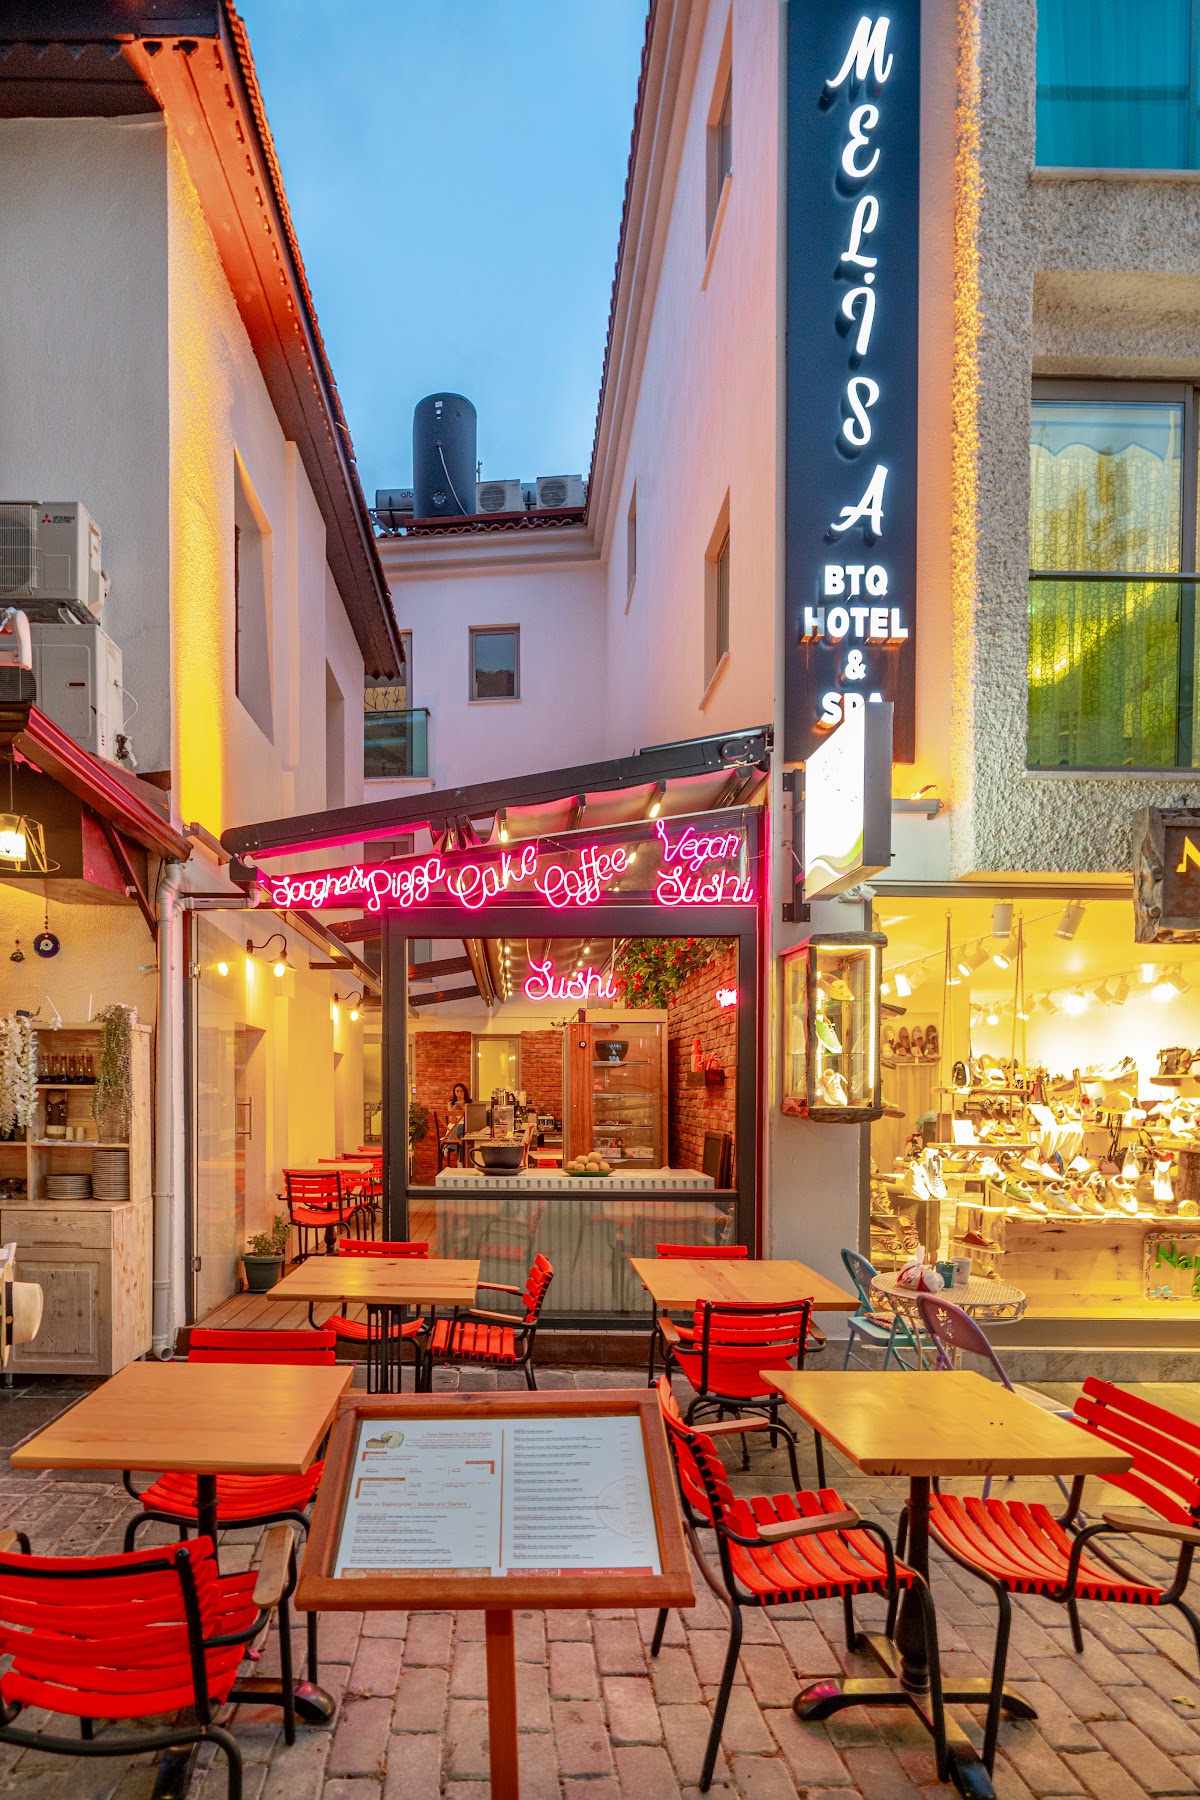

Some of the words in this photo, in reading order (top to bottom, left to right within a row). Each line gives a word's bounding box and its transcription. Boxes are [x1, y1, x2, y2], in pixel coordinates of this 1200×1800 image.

[824, 565, 889, 598] BTQ
[804, 607, 909, 639] HOTEL
[844, 649, 867, 681] &
[656, 818, 741, 871] Vegan
[366, 858, 446, 911] Pizza
[447, 845, 537, 909] Cake
[534, 845, 629, 908] Coffee
[656, 865, 754, 906] Sushi
[525, 960, 617, 1000] Sushi
